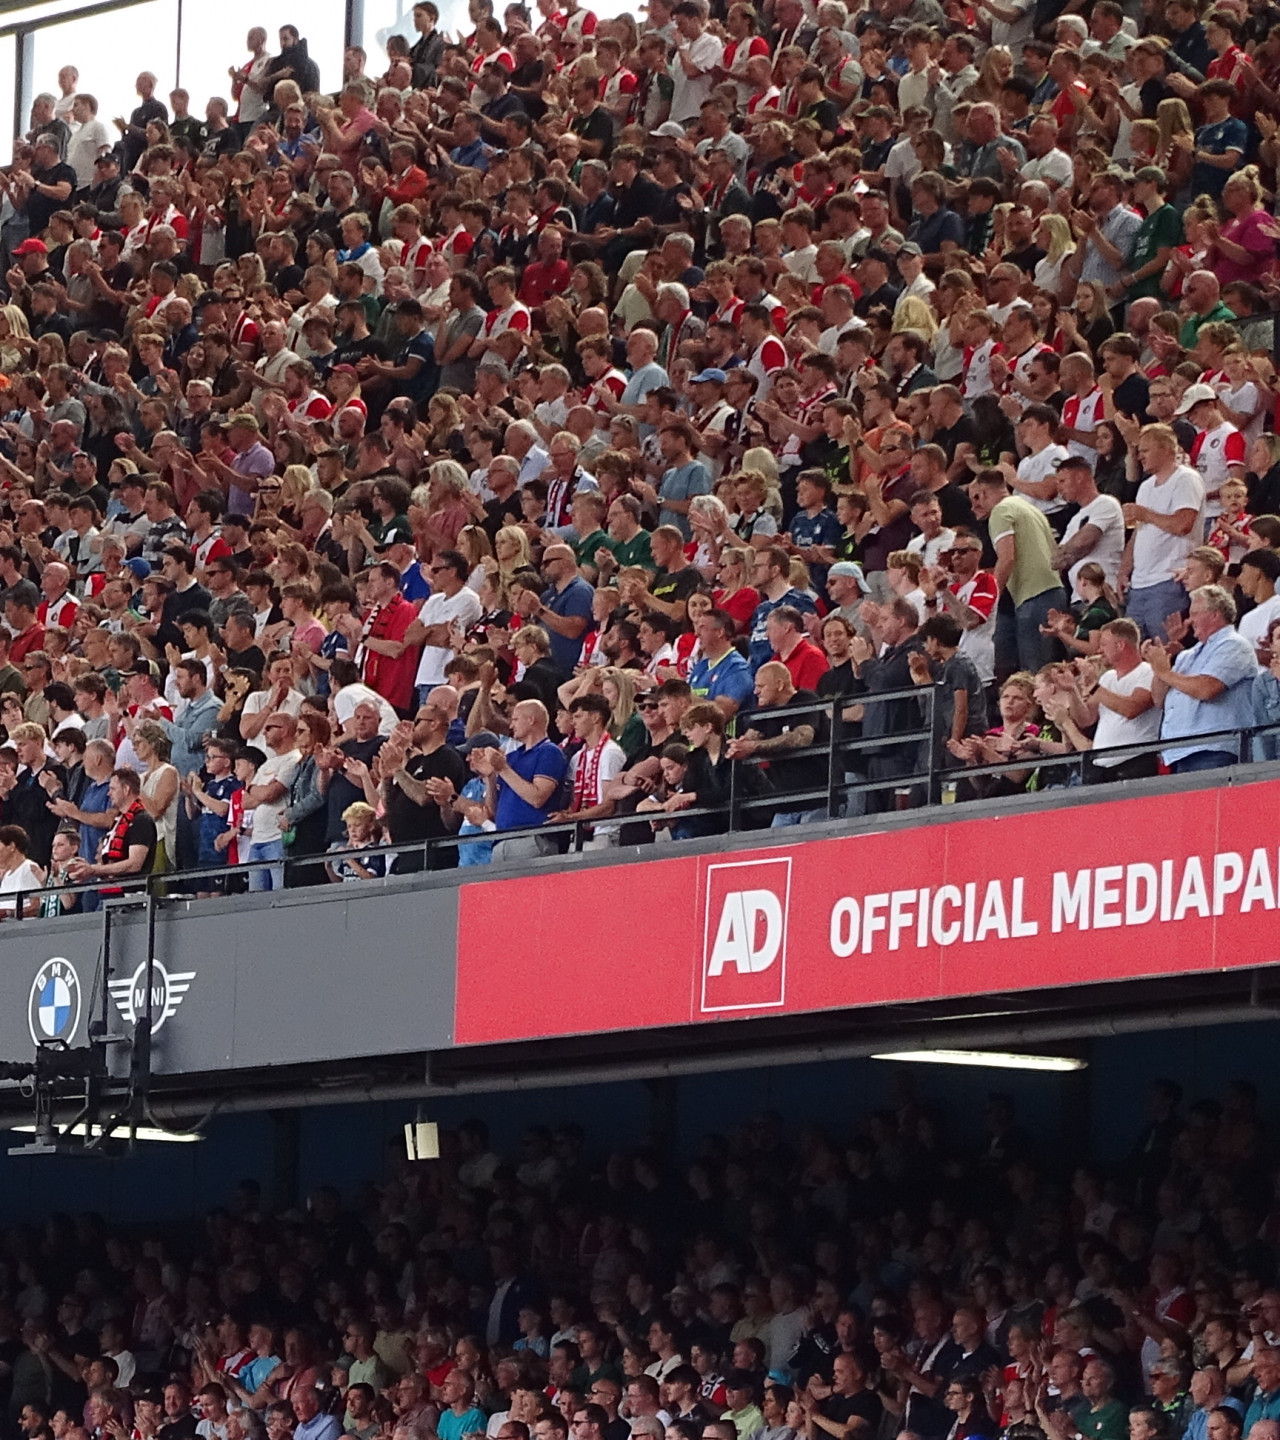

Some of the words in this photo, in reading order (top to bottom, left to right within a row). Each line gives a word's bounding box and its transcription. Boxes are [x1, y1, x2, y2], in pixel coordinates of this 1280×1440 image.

[707, 889, 783, 977] AD
[830, 876, 1039, 959] OFFICIAL
[1051, 845, 1280, 933] MEDIAPA
[134, 987, 165, 1009] MNI
